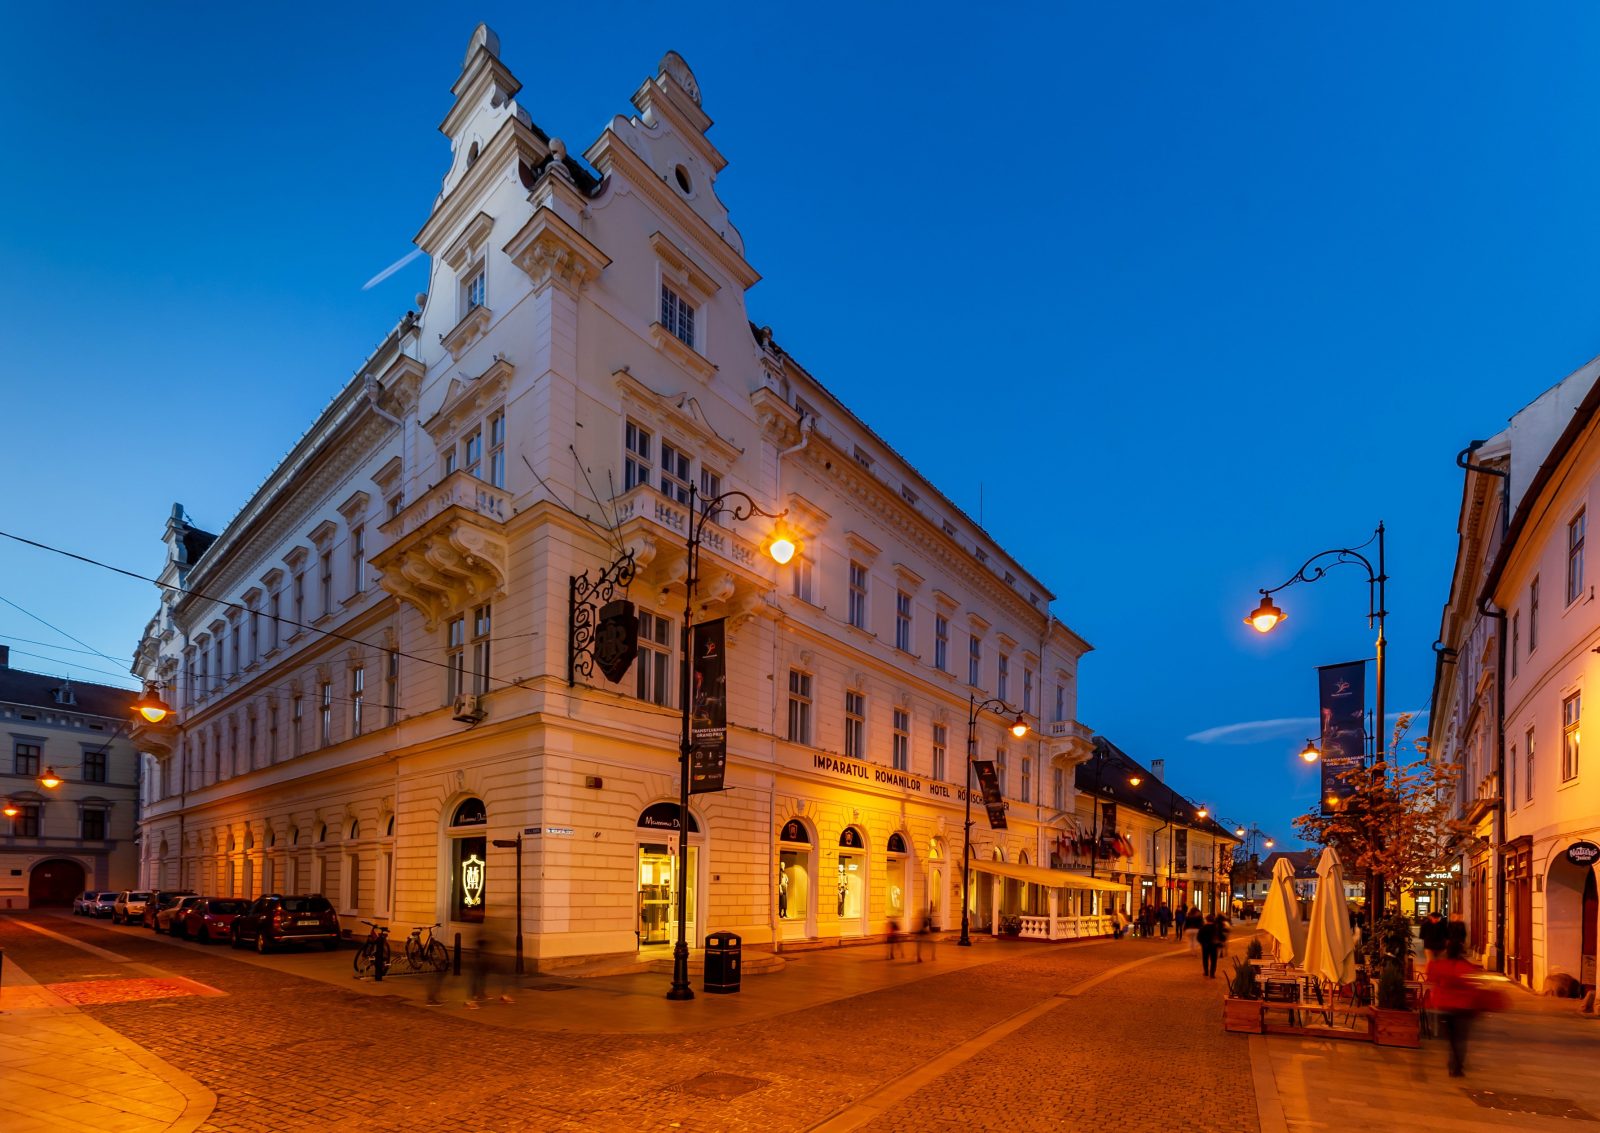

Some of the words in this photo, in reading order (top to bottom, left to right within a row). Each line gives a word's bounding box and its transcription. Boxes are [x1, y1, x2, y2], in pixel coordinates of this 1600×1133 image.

[813, 754, 869, 779] IMPARATUL
[875, 769, 921, 791] ROMANILOR
[929, 783, 950, 798] HOTEL
